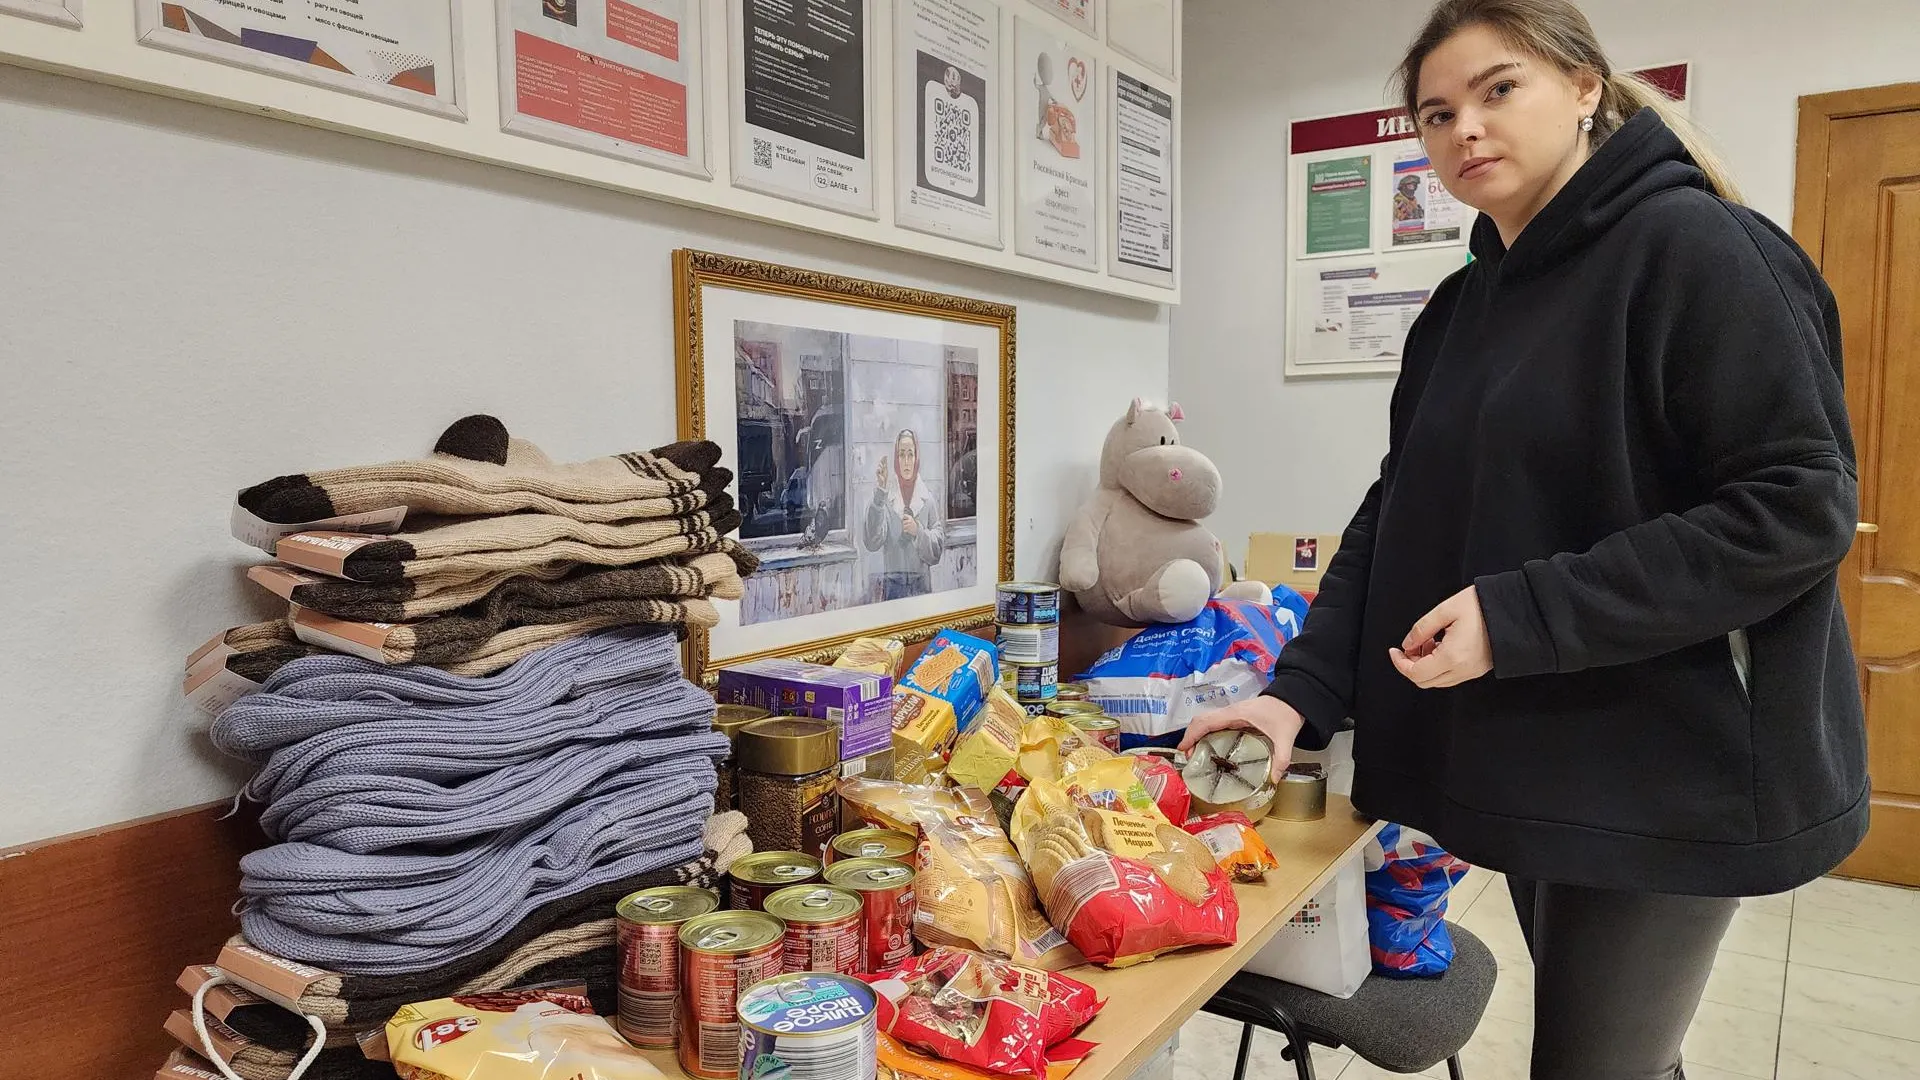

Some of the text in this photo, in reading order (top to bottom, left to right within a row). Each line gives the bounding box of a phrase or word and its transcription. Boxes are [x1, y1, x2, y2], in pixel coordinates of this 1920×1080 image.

[754, 26, 830, 61] ТЕПЕРЬ ЭТУ ПОМОЩЬ МОГУТ
[754, 35, 784, 52] ПОЛУЧИТЬ
[576, 52, 600, 66] Адреа
[776, 145, 797, 155] ЧАТ-БОТ
[780, 153, 806, 166] TELEGRAM
[830, 180, 849, 190] ДАЛЕЕ
[1112, 816, 1147, 829] Печенье
[1124, 837, 1154, 848] Мария
